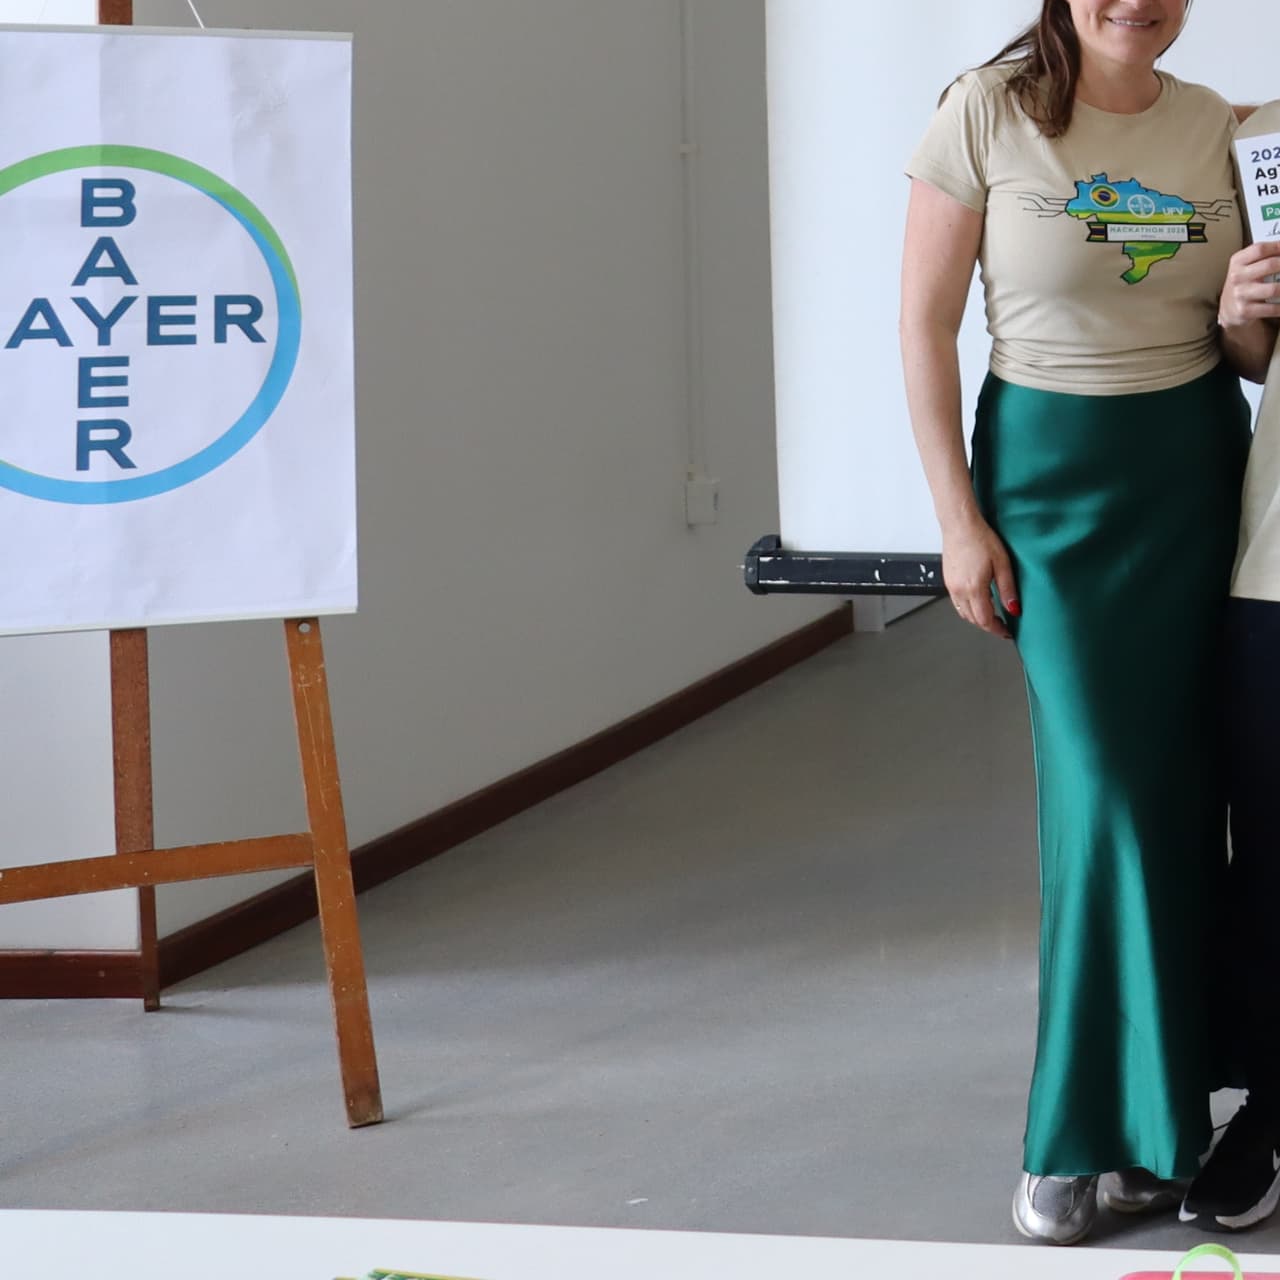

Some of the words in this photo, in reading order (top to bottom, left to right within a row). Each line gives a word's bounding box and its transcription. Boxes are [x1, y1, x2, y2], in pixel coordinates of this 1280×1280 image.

[1162, 207, 1184, 216] UFV
[1110, 226, 1164, 234] HACKATHON
[4, 294, 266, 349] AYER
[71, 178, 138, 471] BAYER
